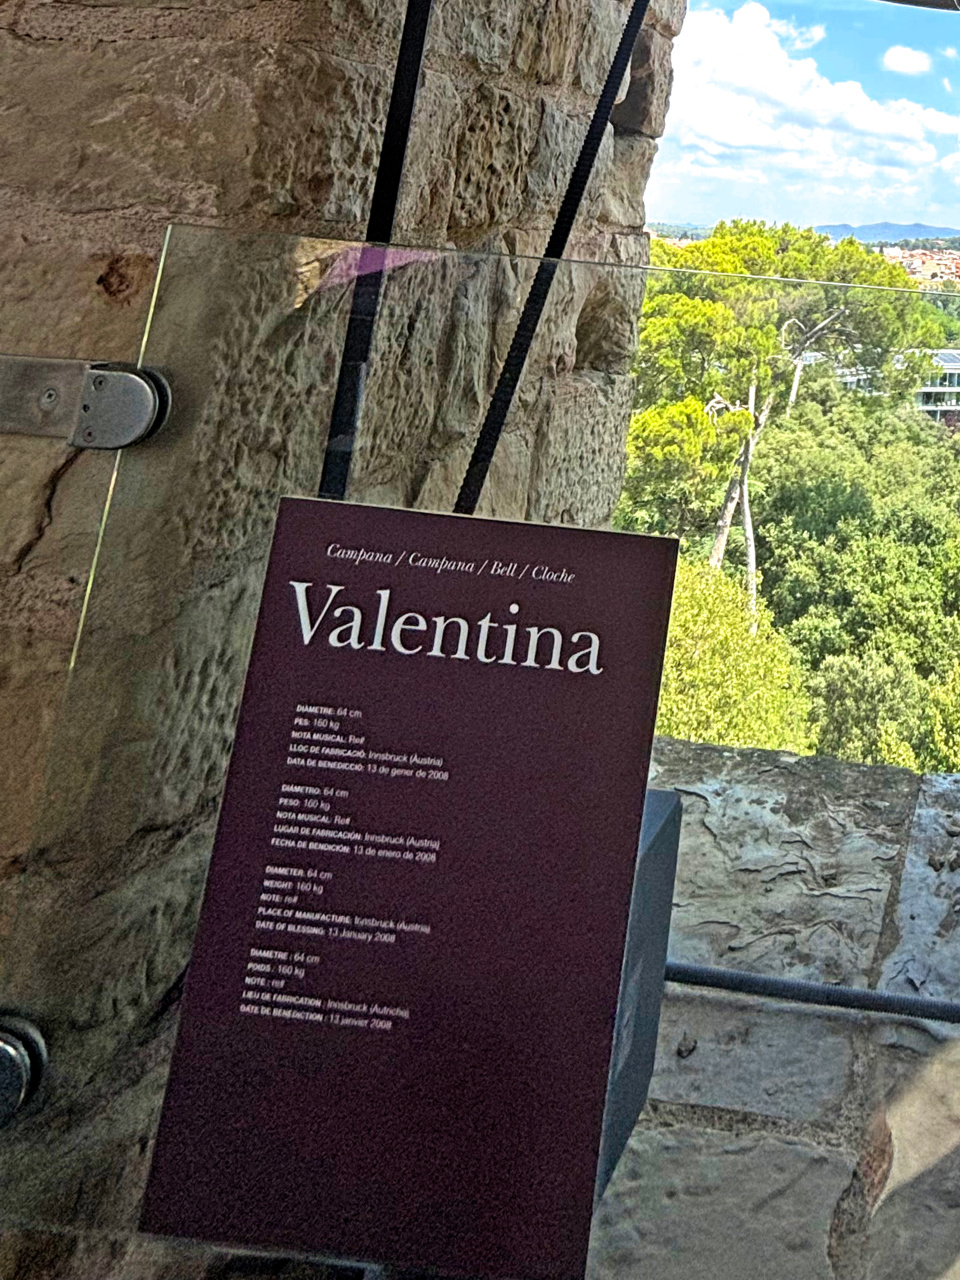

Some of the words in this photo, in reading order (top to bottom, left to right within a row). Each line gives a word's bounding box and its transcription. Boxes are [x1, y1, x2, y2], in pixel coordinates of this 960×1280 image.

[326, 543, 393, 564] Campana
[408, 552, 474, 574] Campana
[490, 561, 517, 577] Bell
[532, 566, 575, 584] Cloche
[289, 581, 603, 675] Valentina
[337, 707, 348, 716] 64
[349, 709, 362, 718] cm
[314, 719, 328, 727] 160
[329, 720, 340, 730] kg
[291, 731, 311, 739] NOTA
[313, 733, 347, 743] MUSICAL:
[289, 744, 308, 752] LLOC
[369, 751, 407, 763] Innsbruck
[287, 757, 305, 765] DATA
[367, 764, 377, 772] 13
[379, 765, 388, 774] de
[391, 767, 413, 777] gener
[416, 769, 426, 778] de
[428, 770, 448, 780] 2008
[323, 787, 334, 796] 64
[335, 789, 348, 798] cm
[304, 799, 318, 808] 160
[320, 801, 330, 811] kg
[276, 811, 296, 819] NOTA
[274, 825, 299, 833] LUGAR
[365, 832, 404, 844] Innsbruck
[271, 838, 295, 847] FECHA
[353, 845, 363, 854] 13
[365, 847, 376, 856] de
[378, 850, 401, 858] enero
[403, 850, 413, 859] de
[415, 852, 436, 862] 2008
[307, 868, 318, 877] 64
[319, 871, 332, 879] cm
[296, 882, 311, 891] 160
[312, 884, 323, 894] kg
[258, 907, 283, 916] PLACE
[283, 909, 293, 918] OF
[354, 916, 395, 928] Innsbruck
[255, 921, 274, 929] DATE
[276, 923, 286, 931] OF
[328, 928, 338, 937] 13
[340, 929, 372, 942] January
[375, 933, 396, 942] 2008
[294, 952, 304, 961] 64
[306, 955, 320, 964] cm
[247, 963, 271, 972] POIDS
[278, 965, 293, 974] 160
[294, 968, 305, 978] kg
[245, 977, 265, 986] NOTE
[242, 991, 260, 999] LIEU
[262, 993, 272, 1001] DE
[272, 994, 321, 1006] FABRICATION
[327, 999, 368, 1012] Innsbruck
[240, 1005, 259, 1014] DATE
[261, 1007, 272, 1015] DE
[329, 1014, 339, 1023] 13
[341, 1018, 368, 1027] janvier
[370, 1020, 392, 1030] 2008
